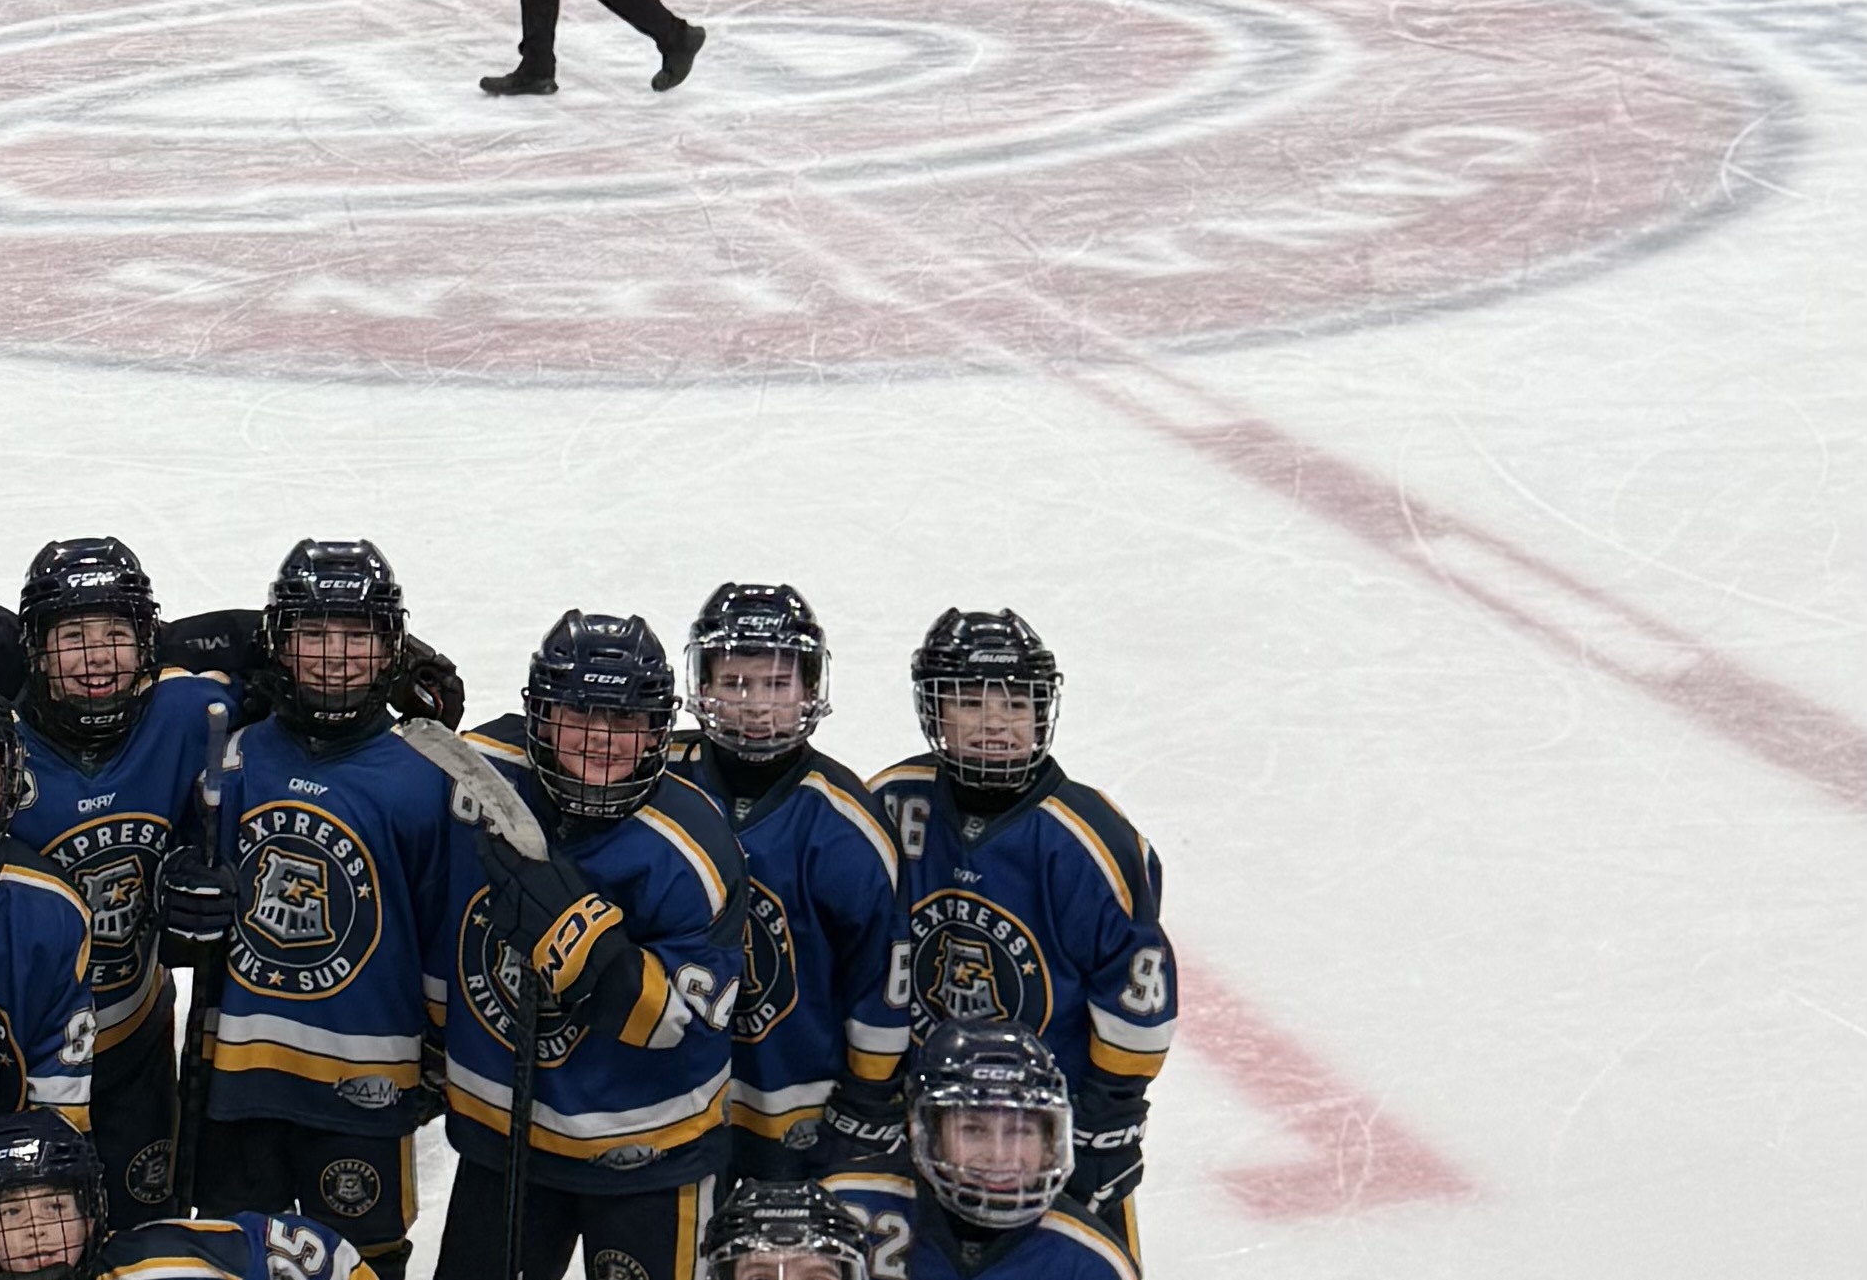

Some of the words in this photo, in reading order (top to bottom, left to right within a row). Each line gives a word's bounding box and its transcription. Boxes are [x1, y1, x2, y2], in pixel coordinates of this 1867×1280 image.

[53, 820, 167, 866] XPRESS
[300, 955, 352, 992] SUD
[466, 973, 511, 1033] RIVE
[537, 1025, 579, 1059] SUD
[972, 1068, 1026, 1081] CCM
